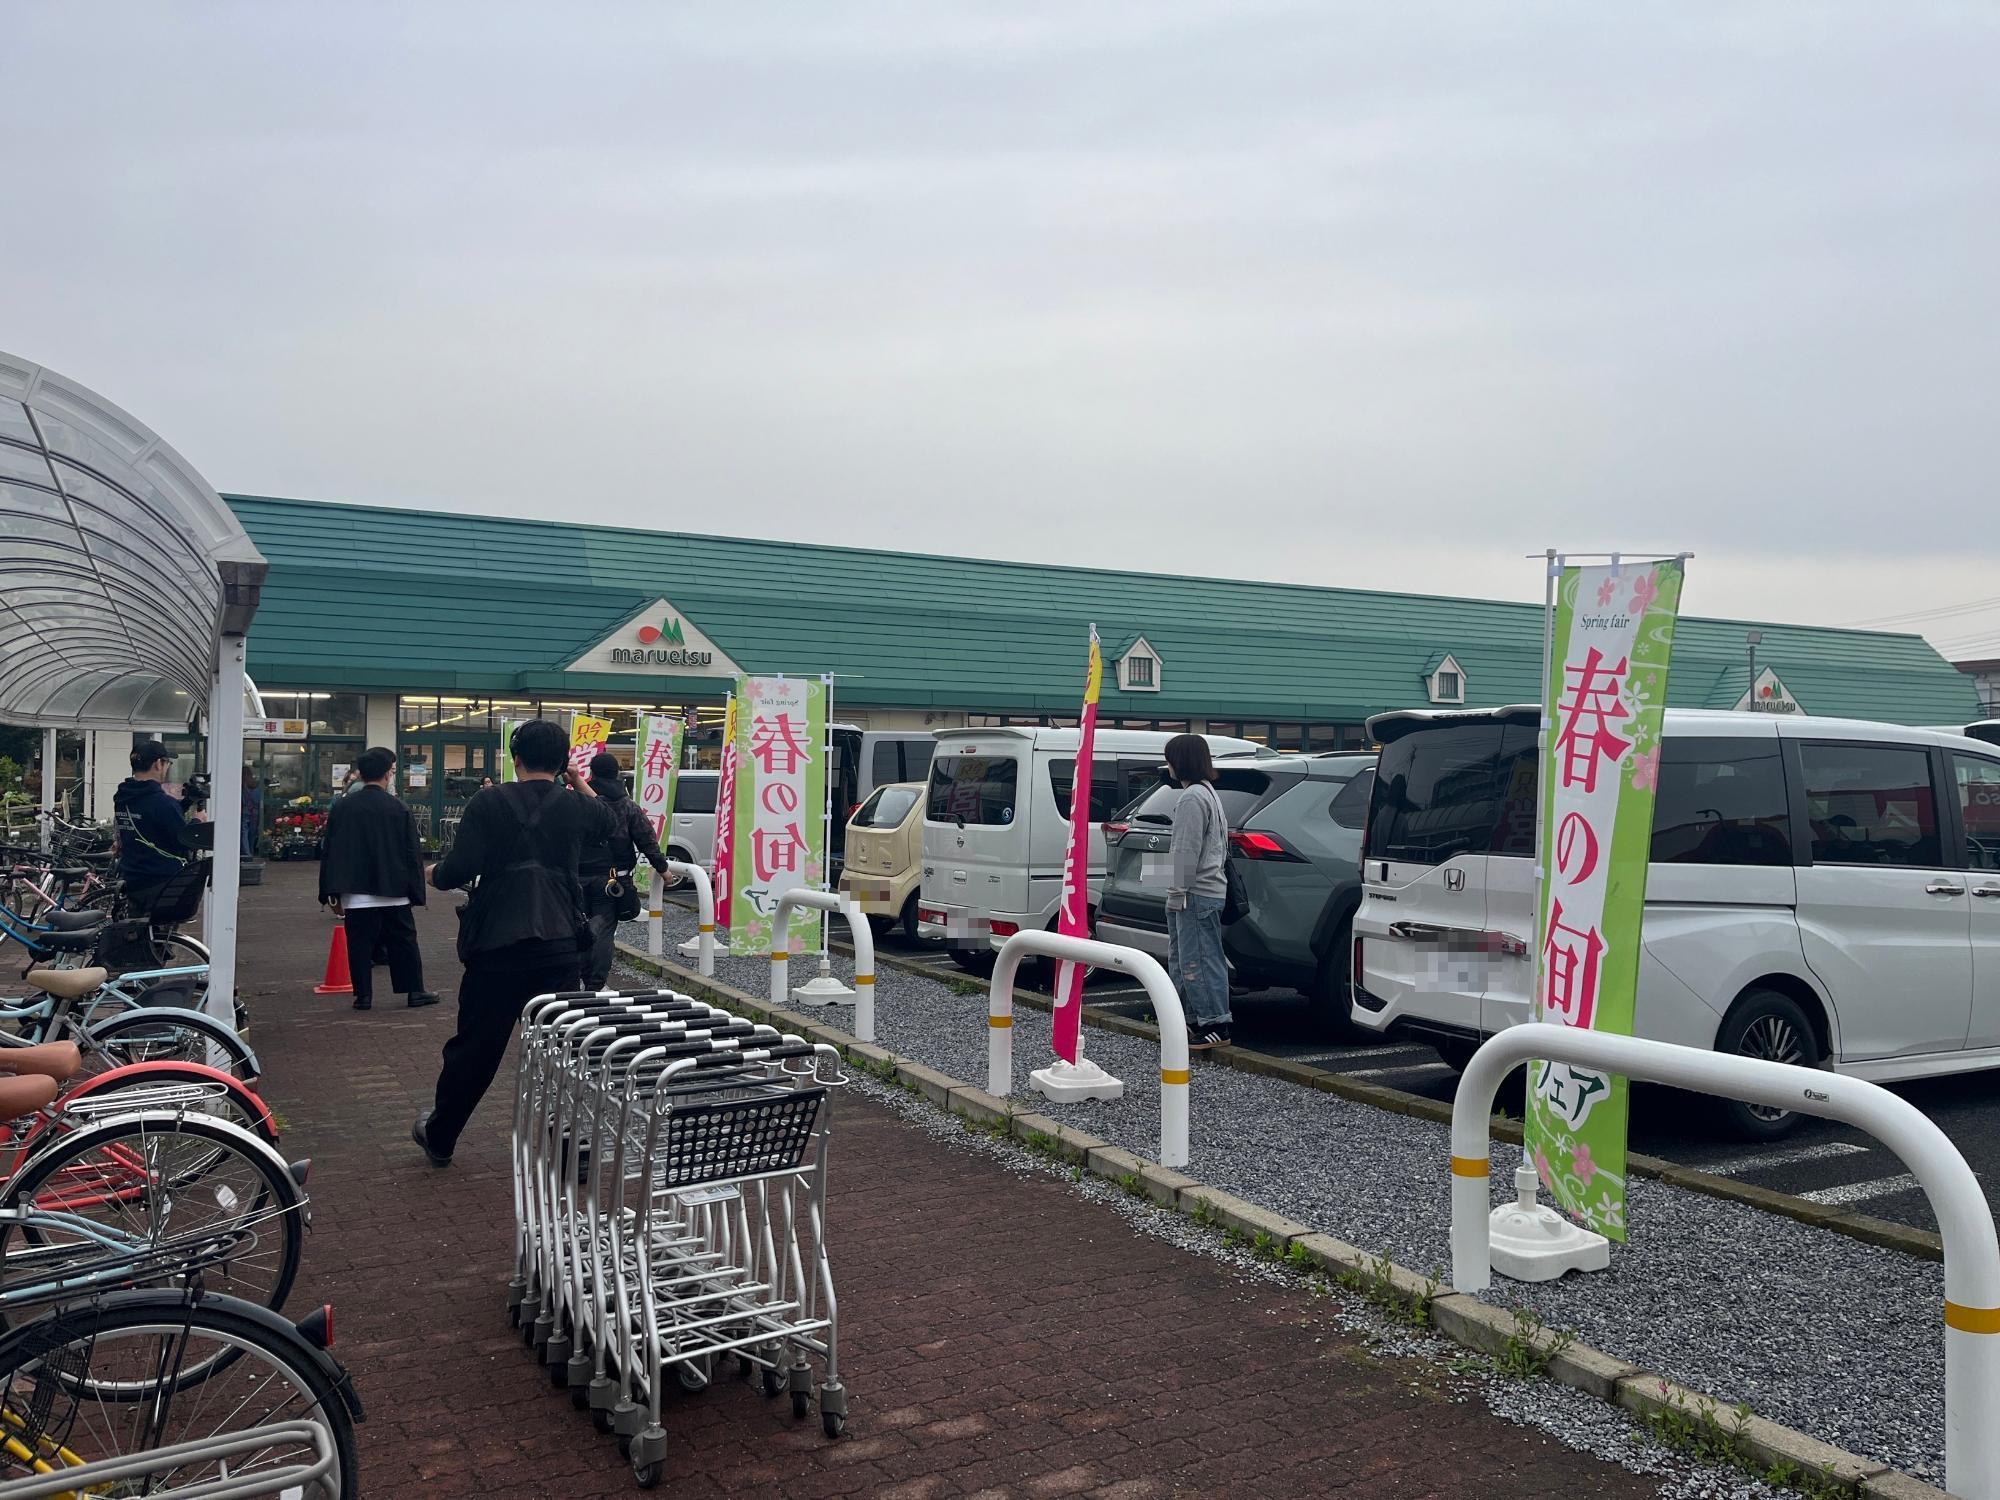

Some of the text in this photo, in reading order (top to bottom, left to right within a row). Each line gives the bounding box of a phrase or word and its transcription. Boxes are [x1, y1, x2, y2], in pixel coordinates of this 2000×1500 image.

[1580, 613, 1630, 631] Spring fair
[610, 647, 712, 667] maruetsu
[575, 721, 603, 741] 只今
[1542, 646, 1632, 1030] 春の旬
